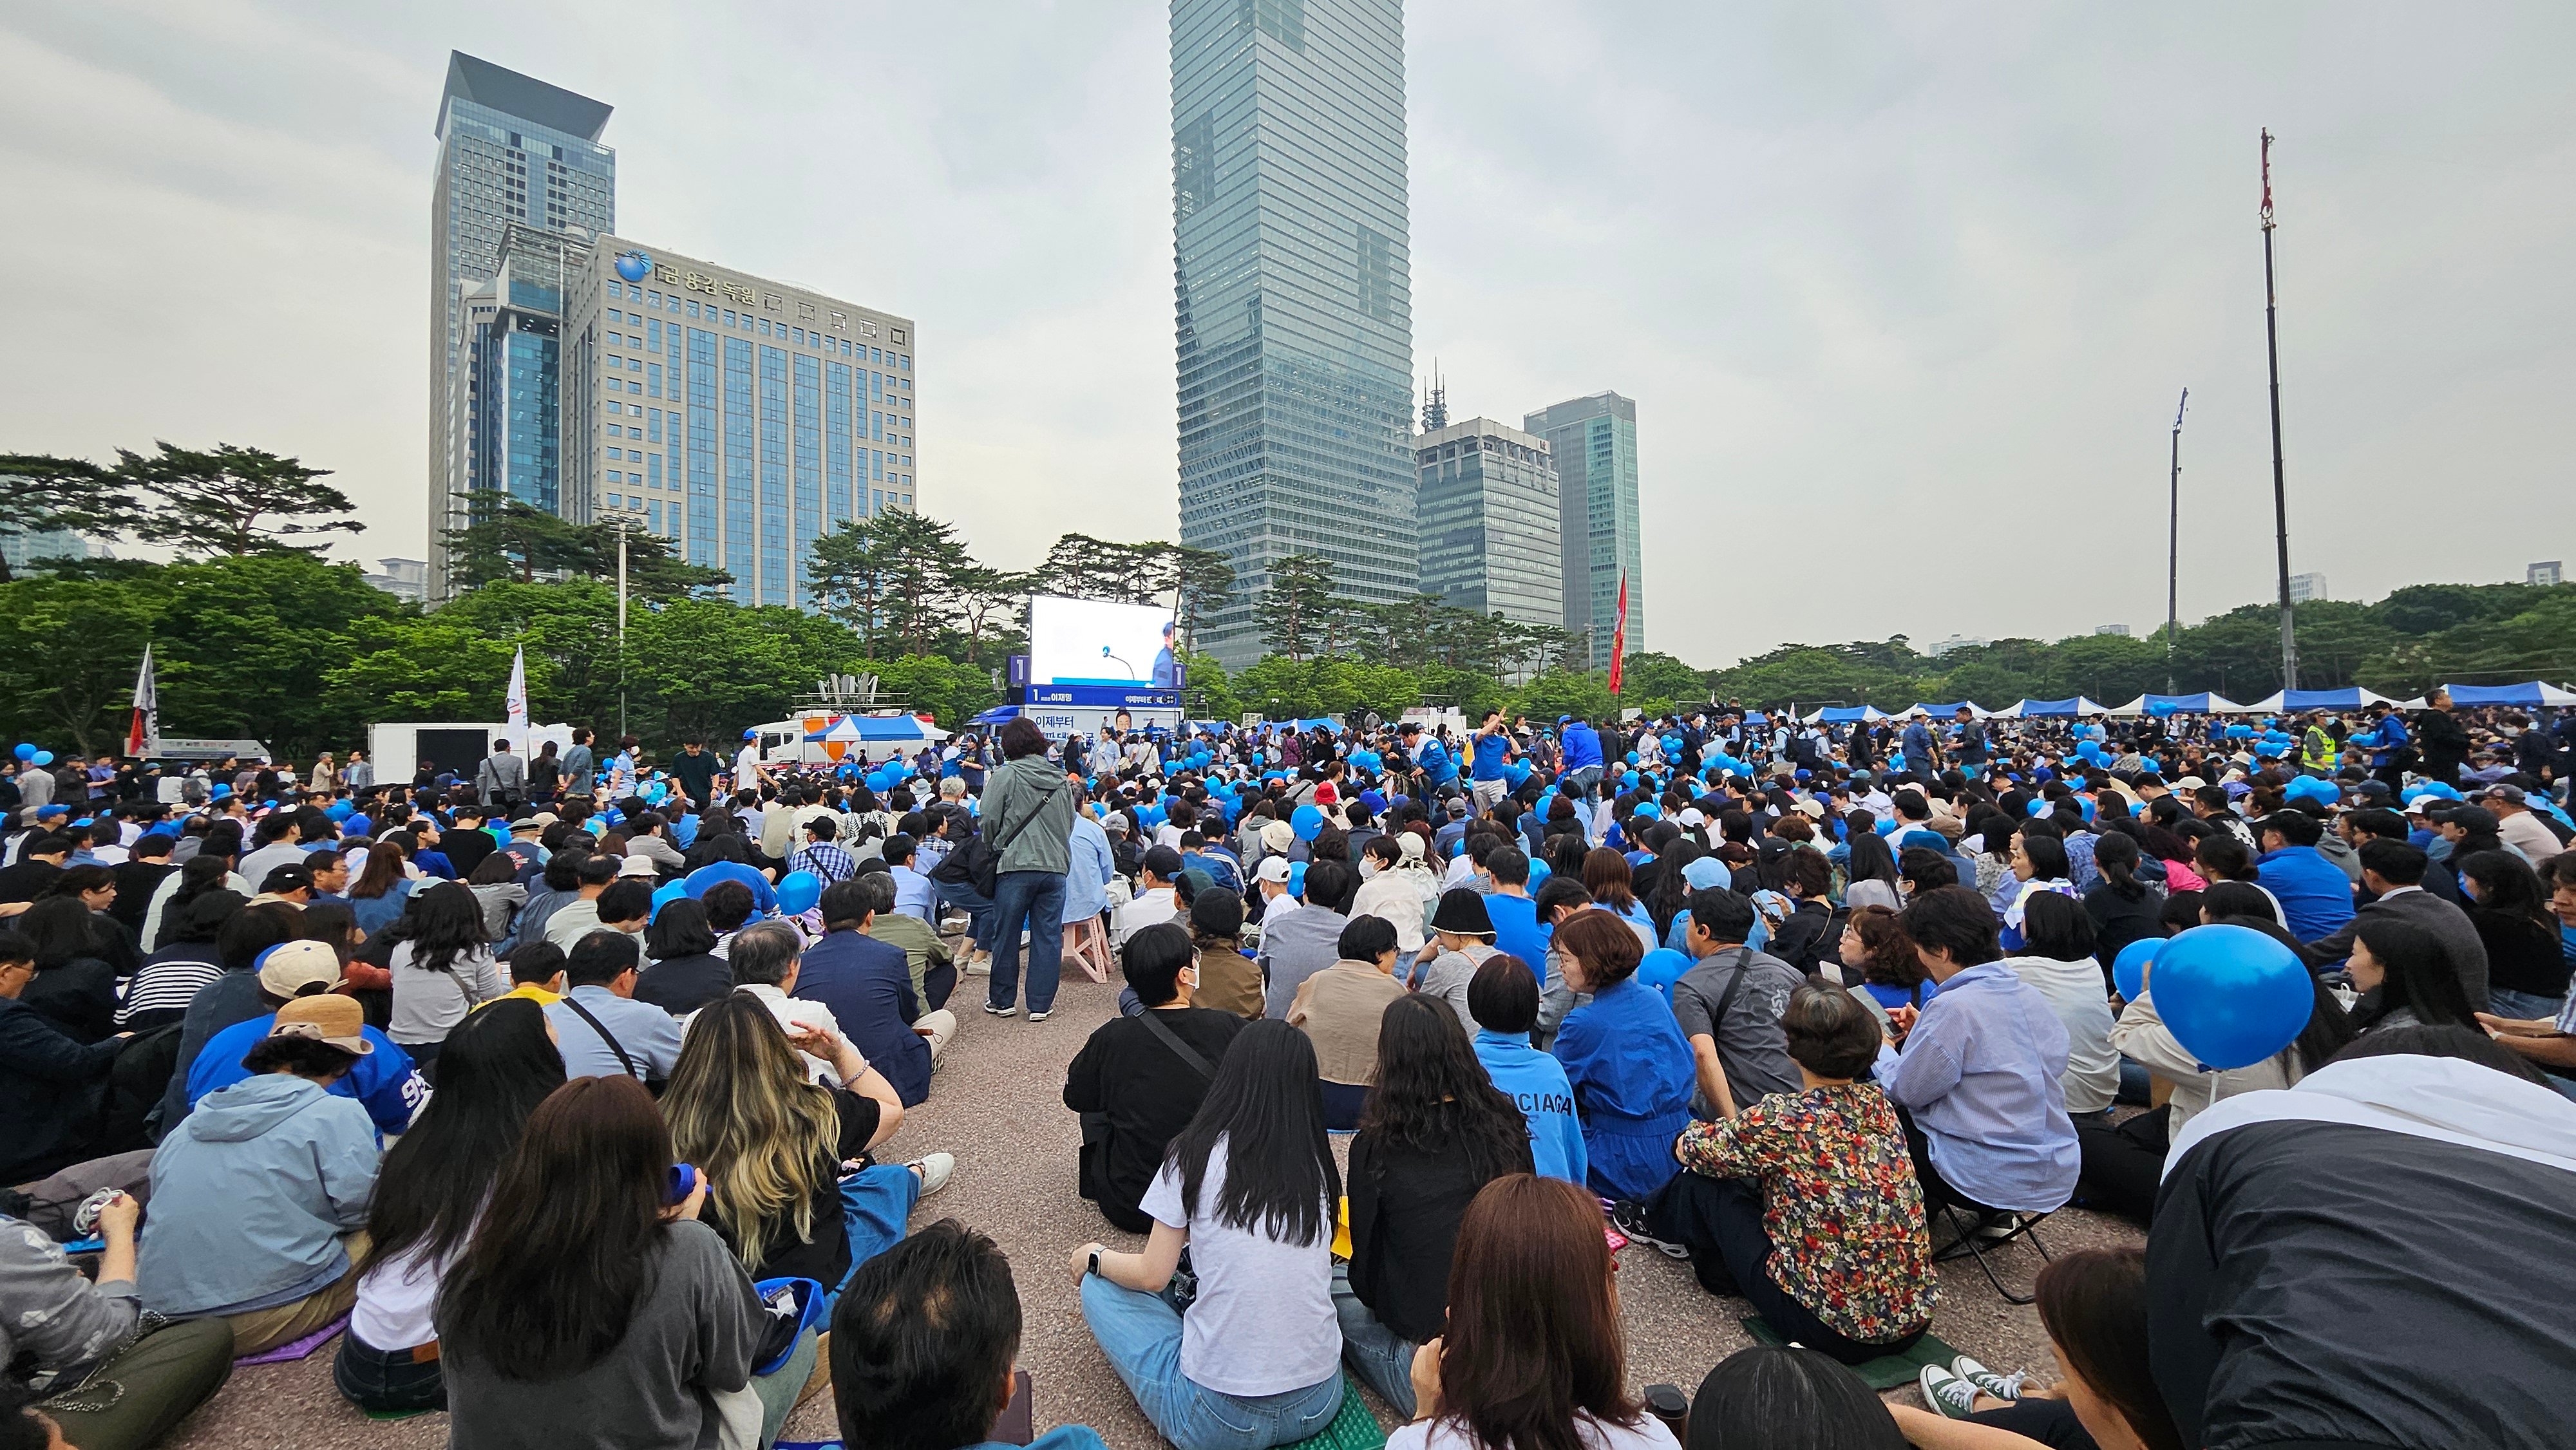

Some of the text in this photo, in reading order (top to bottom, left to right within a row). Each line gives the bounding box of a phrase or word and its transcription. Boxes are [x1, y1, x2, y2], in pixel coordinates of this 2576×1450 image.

[659, 265, 755, 306] 금융감독원
[1016, 659, 1023, 680] 1
[1175, 667, 1182, 686] 1
[1033, 688, 1038, 701] 1
[1050, 693, 1072, 702] 이재명
[1036, 716, 1074, 728] 이제부터
